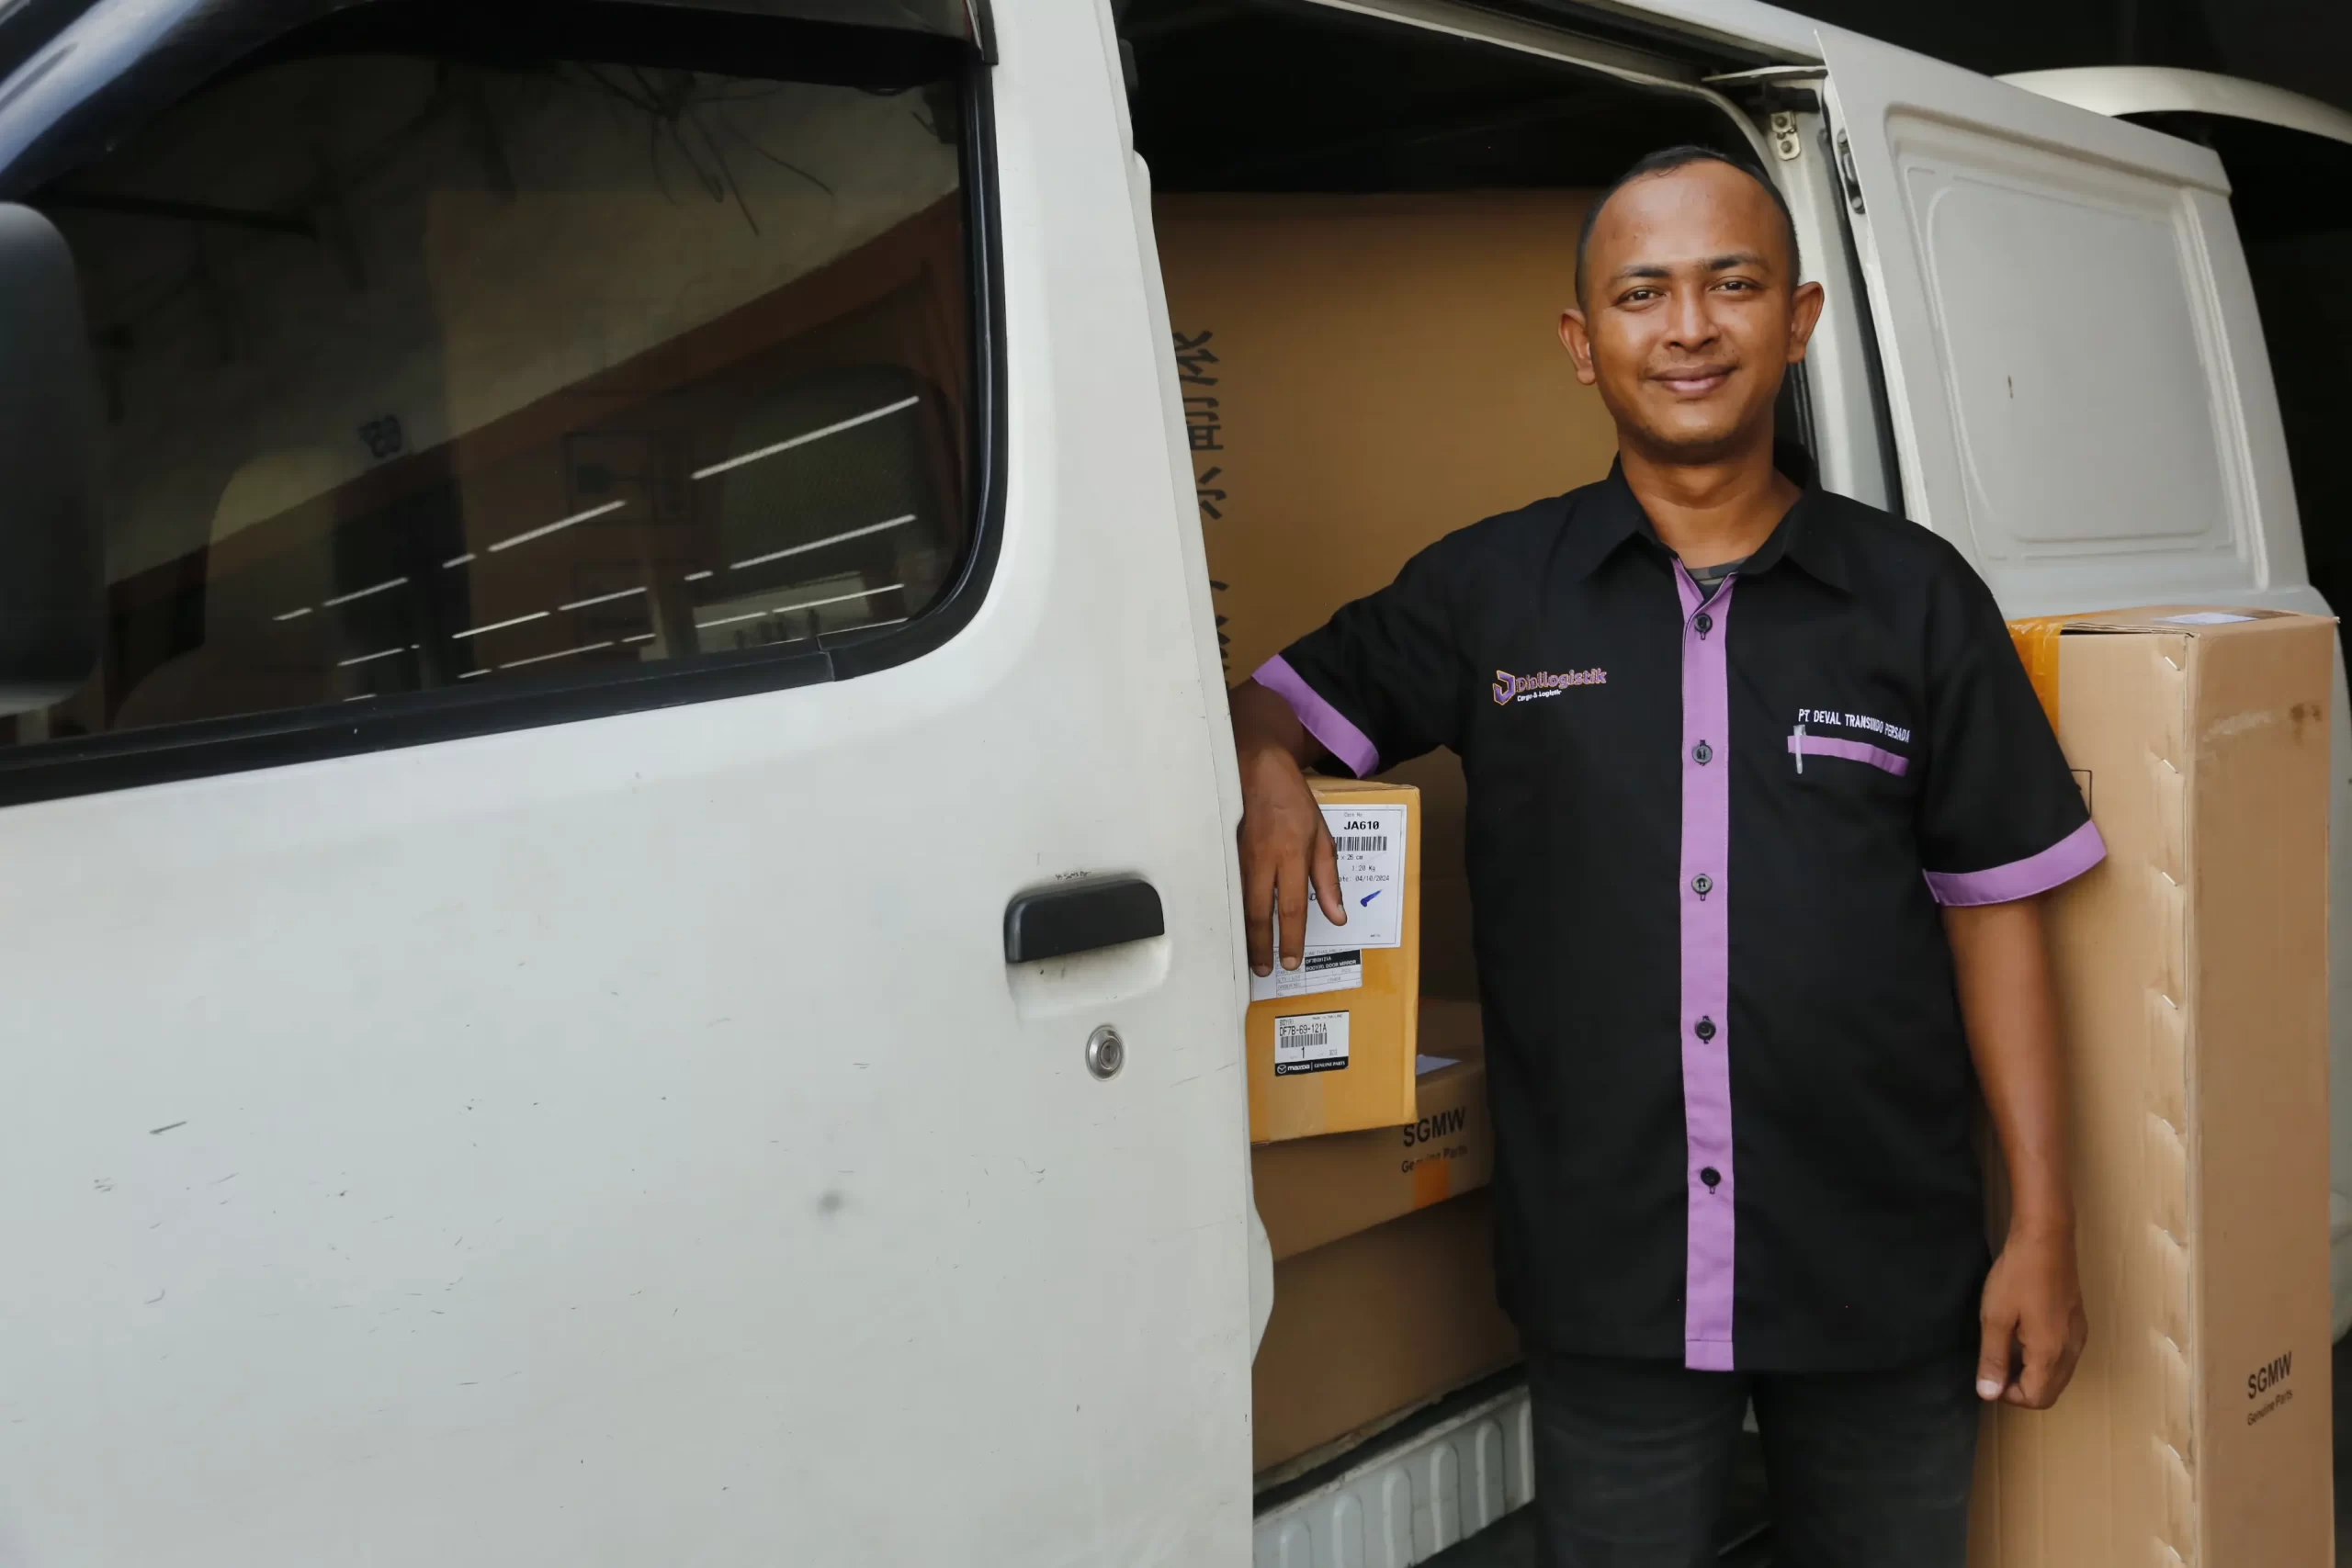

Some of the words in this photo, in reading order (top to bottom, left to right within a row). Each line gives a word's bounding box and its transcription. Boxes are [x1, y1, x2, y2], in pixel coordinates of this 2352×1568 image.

[1798, 708, 1811, 722] PT
[1813, 710, 1841, 726] DEVAL
[1845, 714, 1883, 734] TRANSINDO
[1884, 723, 1911, 743] PERSADA
[1344, 821, 1380, 830] JA610
[1279, 1022, 1328, 1037] DF7B-69-121A
[1301, 1046, 1305, 1059] 1
[1403, 1106, 1466, 1147] SGMW
[2248, 1350, 2292, 1399] SGMW
